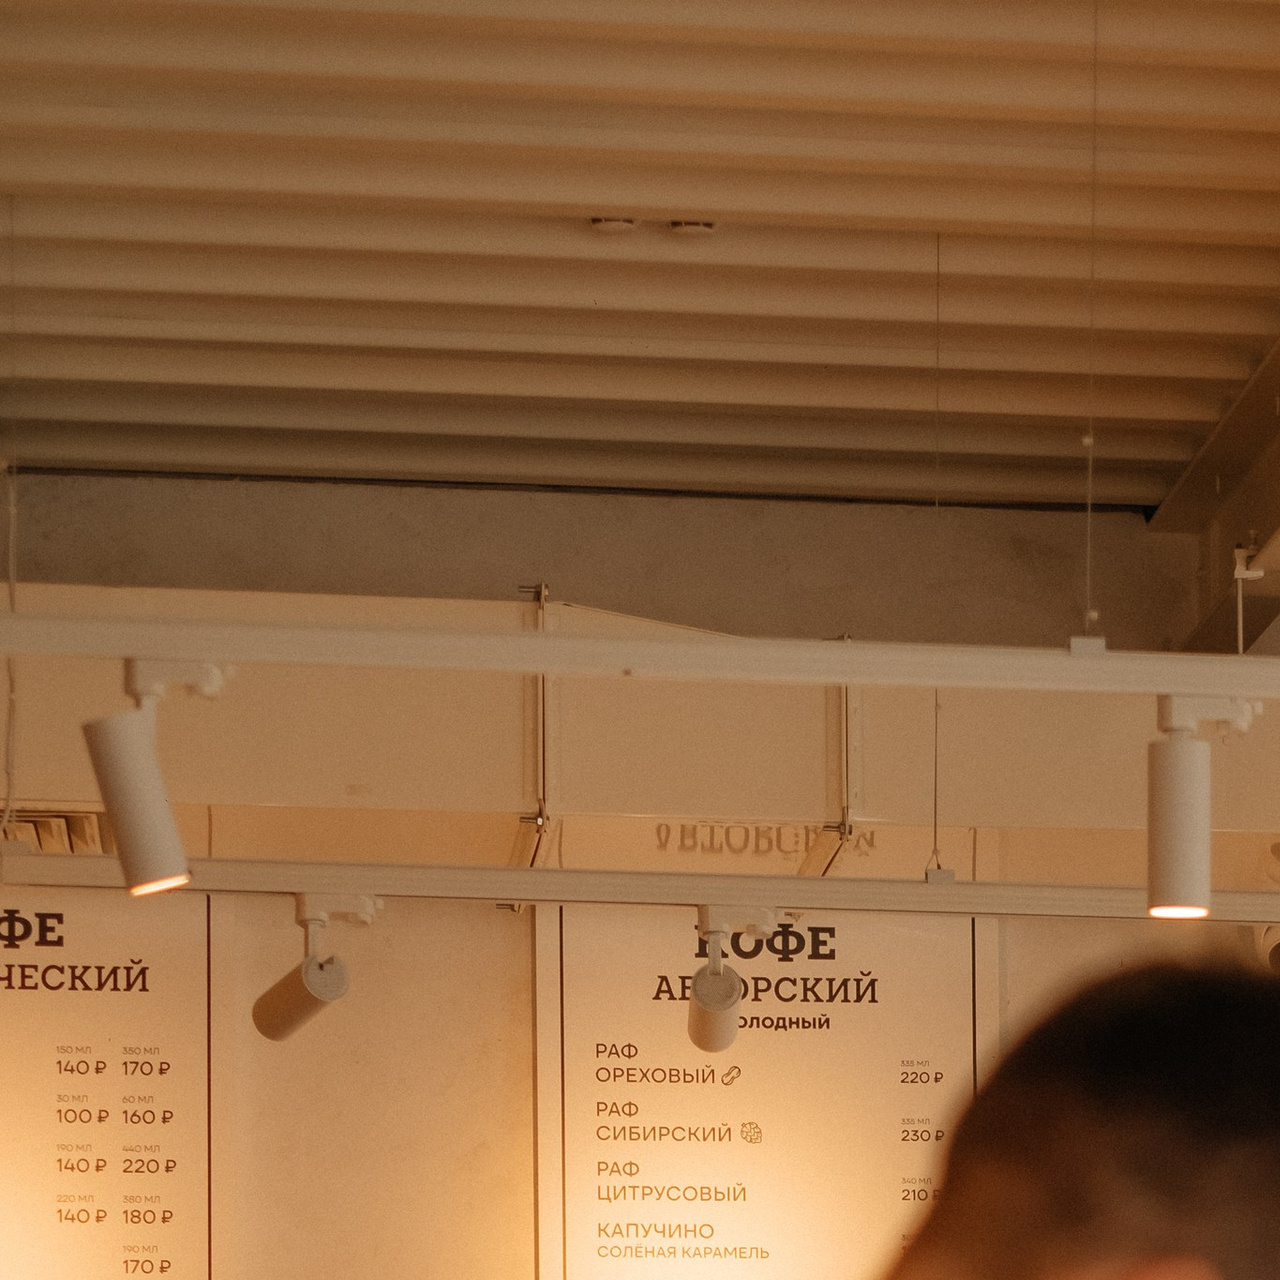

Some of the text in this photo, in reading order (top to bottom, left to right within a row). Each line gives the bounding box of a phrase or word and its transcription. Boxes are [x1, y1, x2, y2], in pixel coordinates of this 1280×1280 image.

[739, 1013, 830, 1032] олодный
[595, 1042, 639, 1060] РАФ
[56, 1059, 107, 1076] 140 ₽
[122, 1060, 171, 1077] 170 ₽
[595, 1064, 715, 1084] ОРЕХОВЫЙ
[900, 1071, 944, 1084] 220 ₽
[56, 1108, 110, 1124] 100 ₽
[122, 1109, 174, 1125] 160 ₽
[596, 1101, 639, 1118] РАФ
[595, 1122, 732, 1142] СИБИРСКИЙ
[900, 1129, 932, 1142] 230
[56, 1157, 108, 1174] 140 ₽
[122, 1158, 177, 1174] 220 ₽
[597, 1160, 640, 1178] РАФ
[597, 1182, 747, 1204] ЦИТРУСОВЫЙ
[901, 1188, 929, 1202] 210
[56, 1208, 108, 1224] 140 ₽
[122, 1209, 174, 1225] 180 ₽
[597, 1222, 715, 1240] КАПУЧИНО
[596, 1245, 770, 1260] СОЛЁНАЯ КАРАМЕЛЬ
[122, 1259, 172, 1275] 170 ₽
